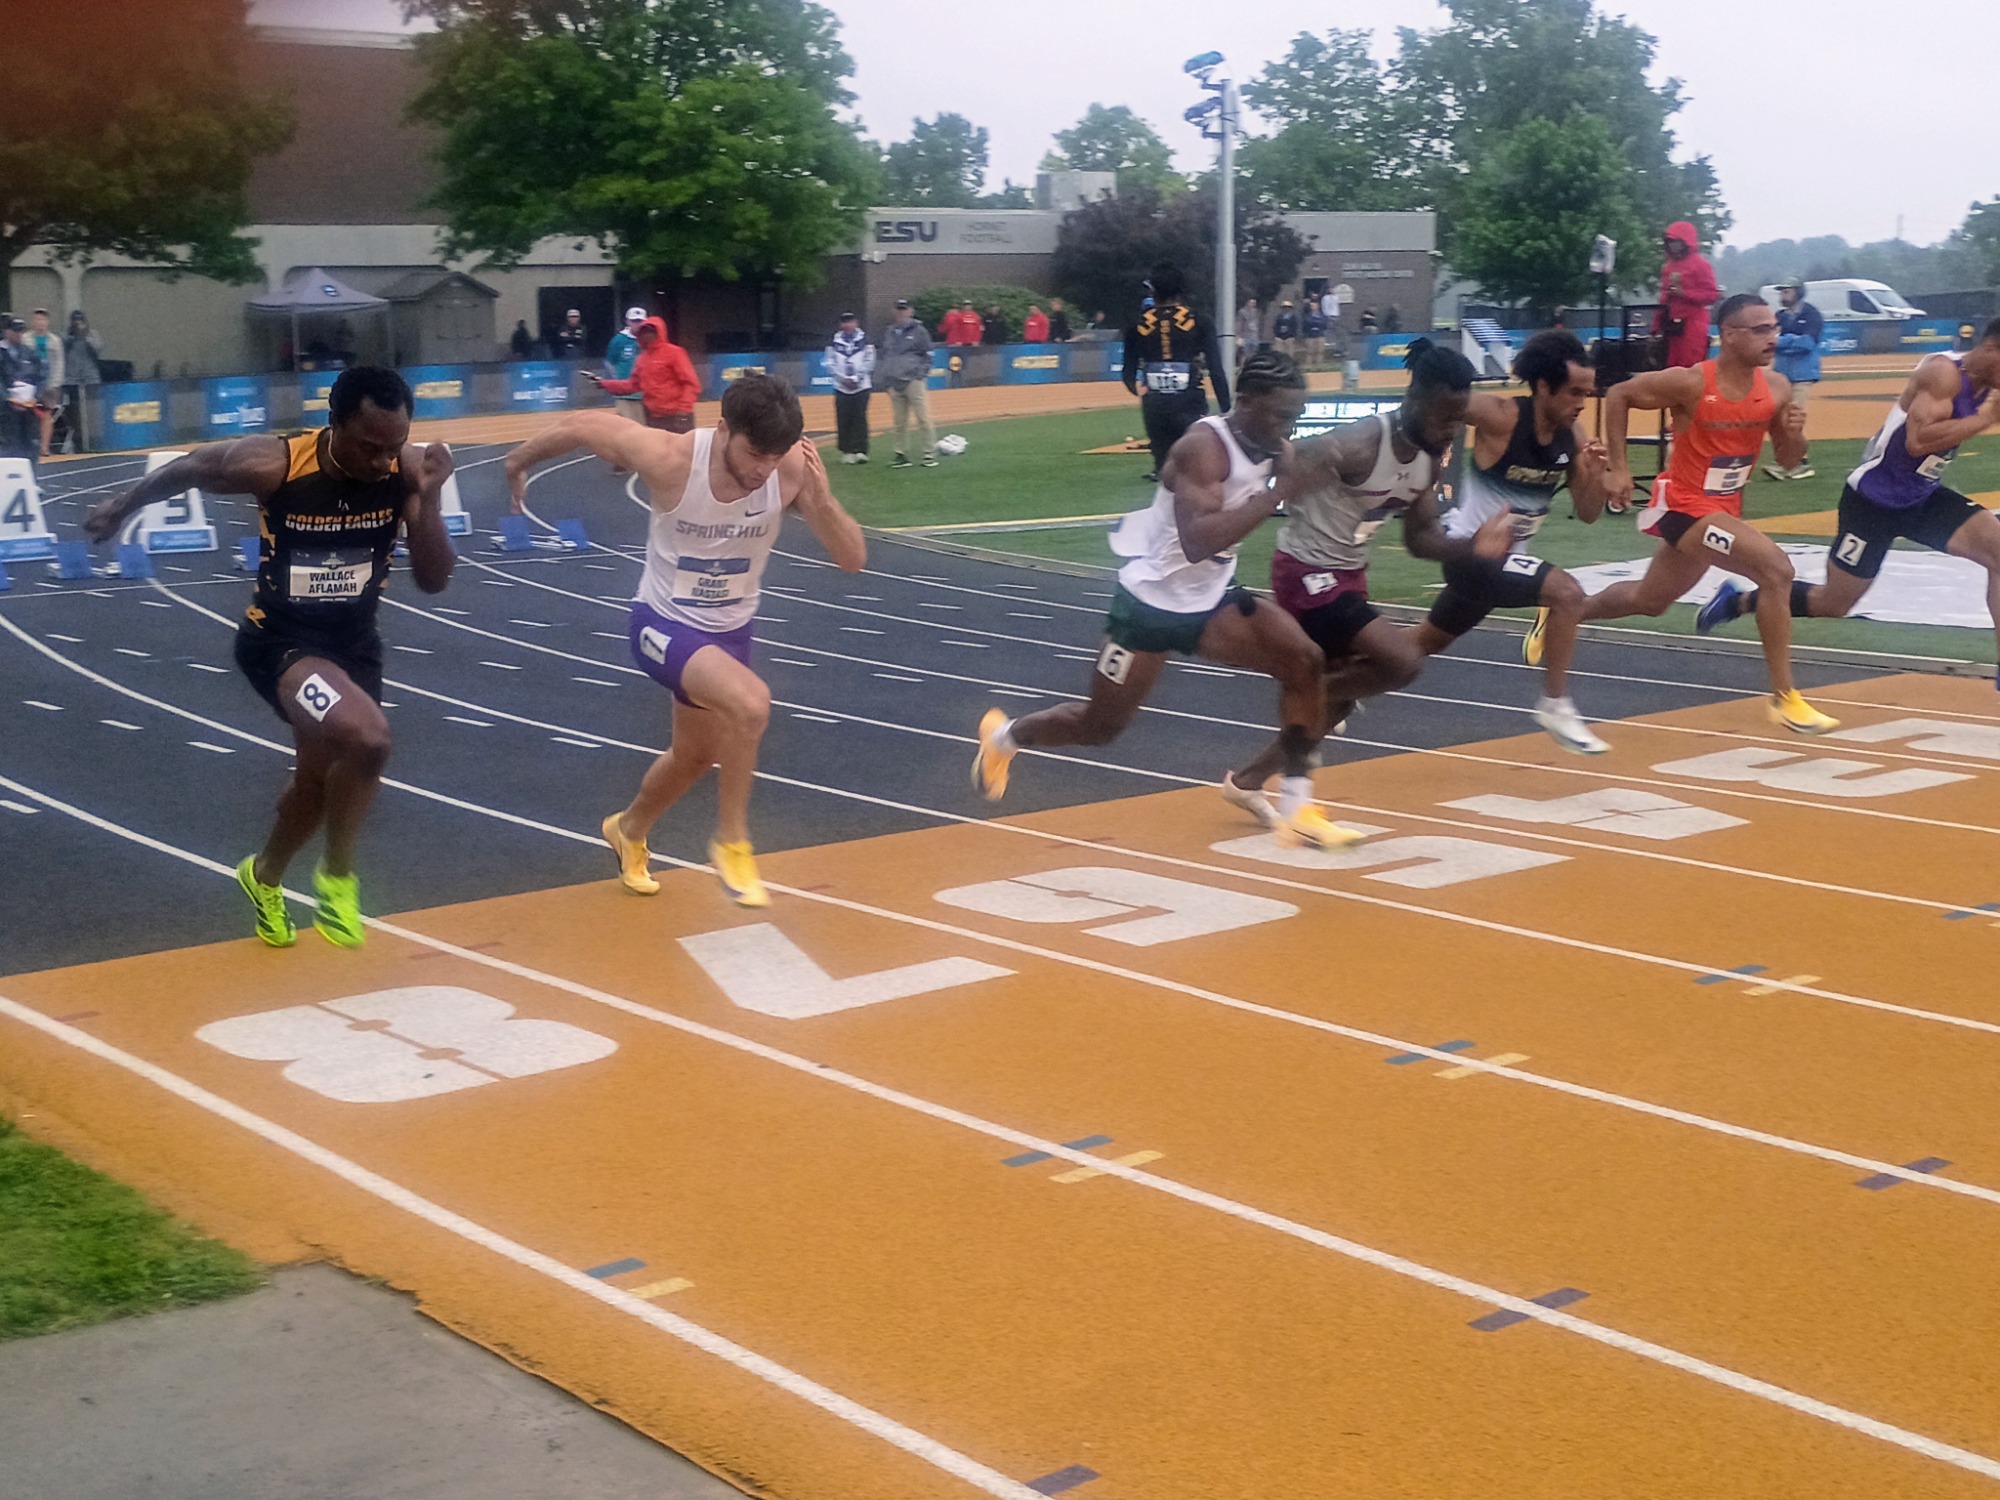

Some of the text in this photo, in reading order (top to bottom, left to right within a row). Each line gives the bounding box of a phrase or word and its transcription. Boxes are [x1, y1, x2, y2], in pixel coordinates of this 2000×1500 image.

[875, 221, 938, 243] ESU
[3, 488, 36, 532] 4
[285, 508, 394, 532] GOLDEN EAGLES
[675, 519, 735, 539] SPRING
[1707, 531, 1730, 550] 3
[1511, 557, 1540, 570] 4
[1843, 538, 1860, 562] 2
[308, 582, 357, 594] AFLAMAH
[309, 570, 357, 582] WALLACE
[303, 682, 331, 712] 8
[1649, 746, 1980, 798] 3
[1434, 787, 1752, 840] 4
[1209, 820, 1575, 889] 5
[933, 866, 1301, 946] 6
[675, 921, 1020, 1020] 7
[193, 984, 621, 1104] 8
